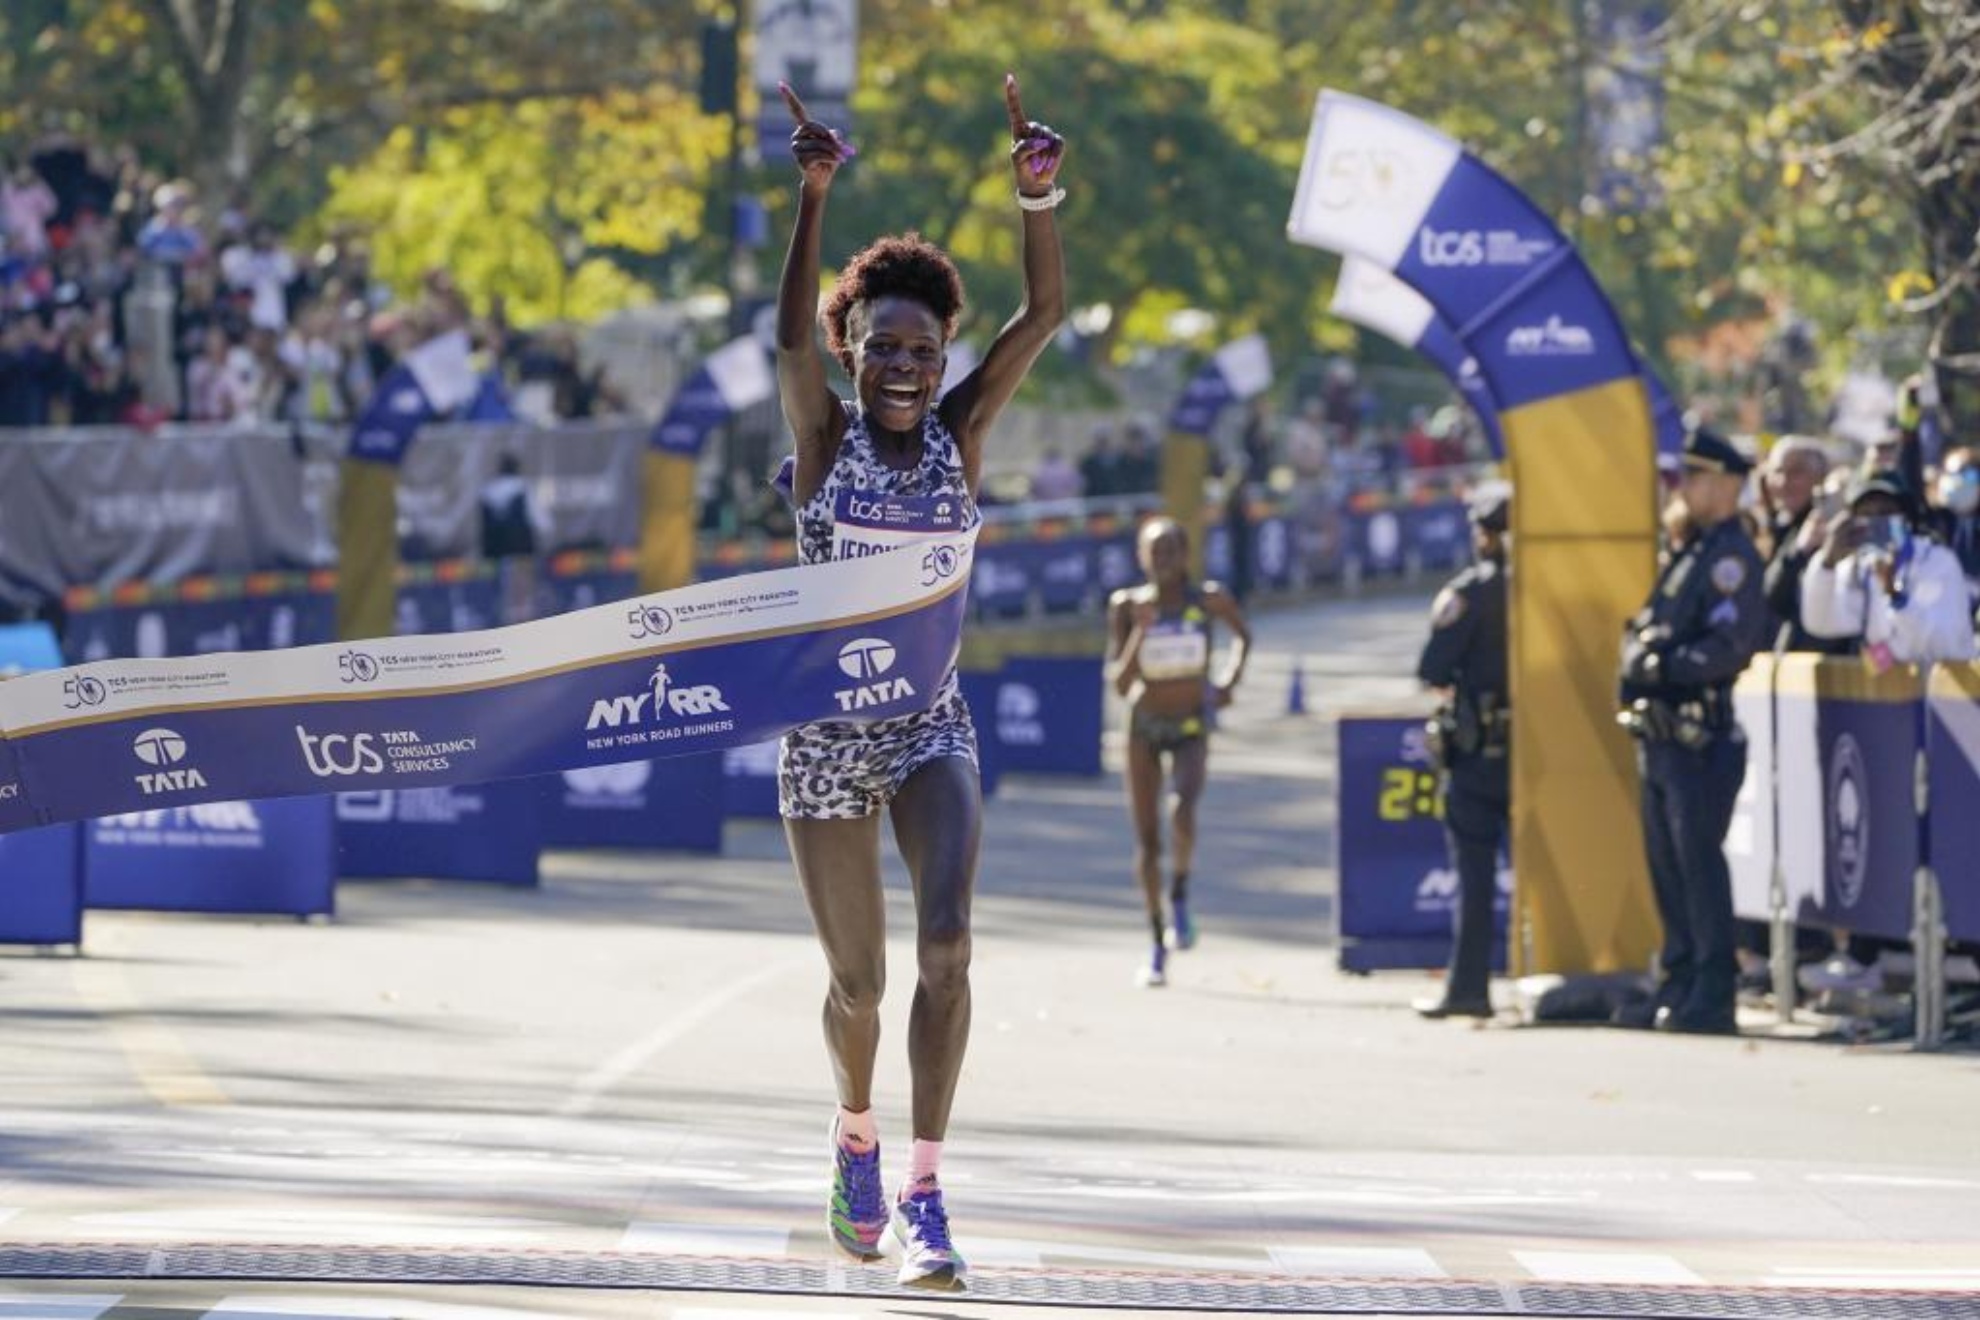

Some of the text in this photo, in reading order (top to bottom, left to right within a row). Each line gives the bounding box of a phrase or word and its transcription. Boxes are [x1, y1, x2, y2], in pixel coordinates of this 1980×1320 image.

[1420, 224, 1484, 266] tcs
[850, 495, 882, 520] tcs
[674, 605, 694, 615] TCS
[834, 677, 915, 711] TATA
[380, 731, 420, 744] TATA
[587, 719, 734, 750] NEW YORK ROAD RUNNERS
[296, 725, 383, 776] tcs
[387, 739, 476, 758] CONSULTANCY
[392, 757, 449, 773] SERVICES
[135, 768, 207, 794] TATA
